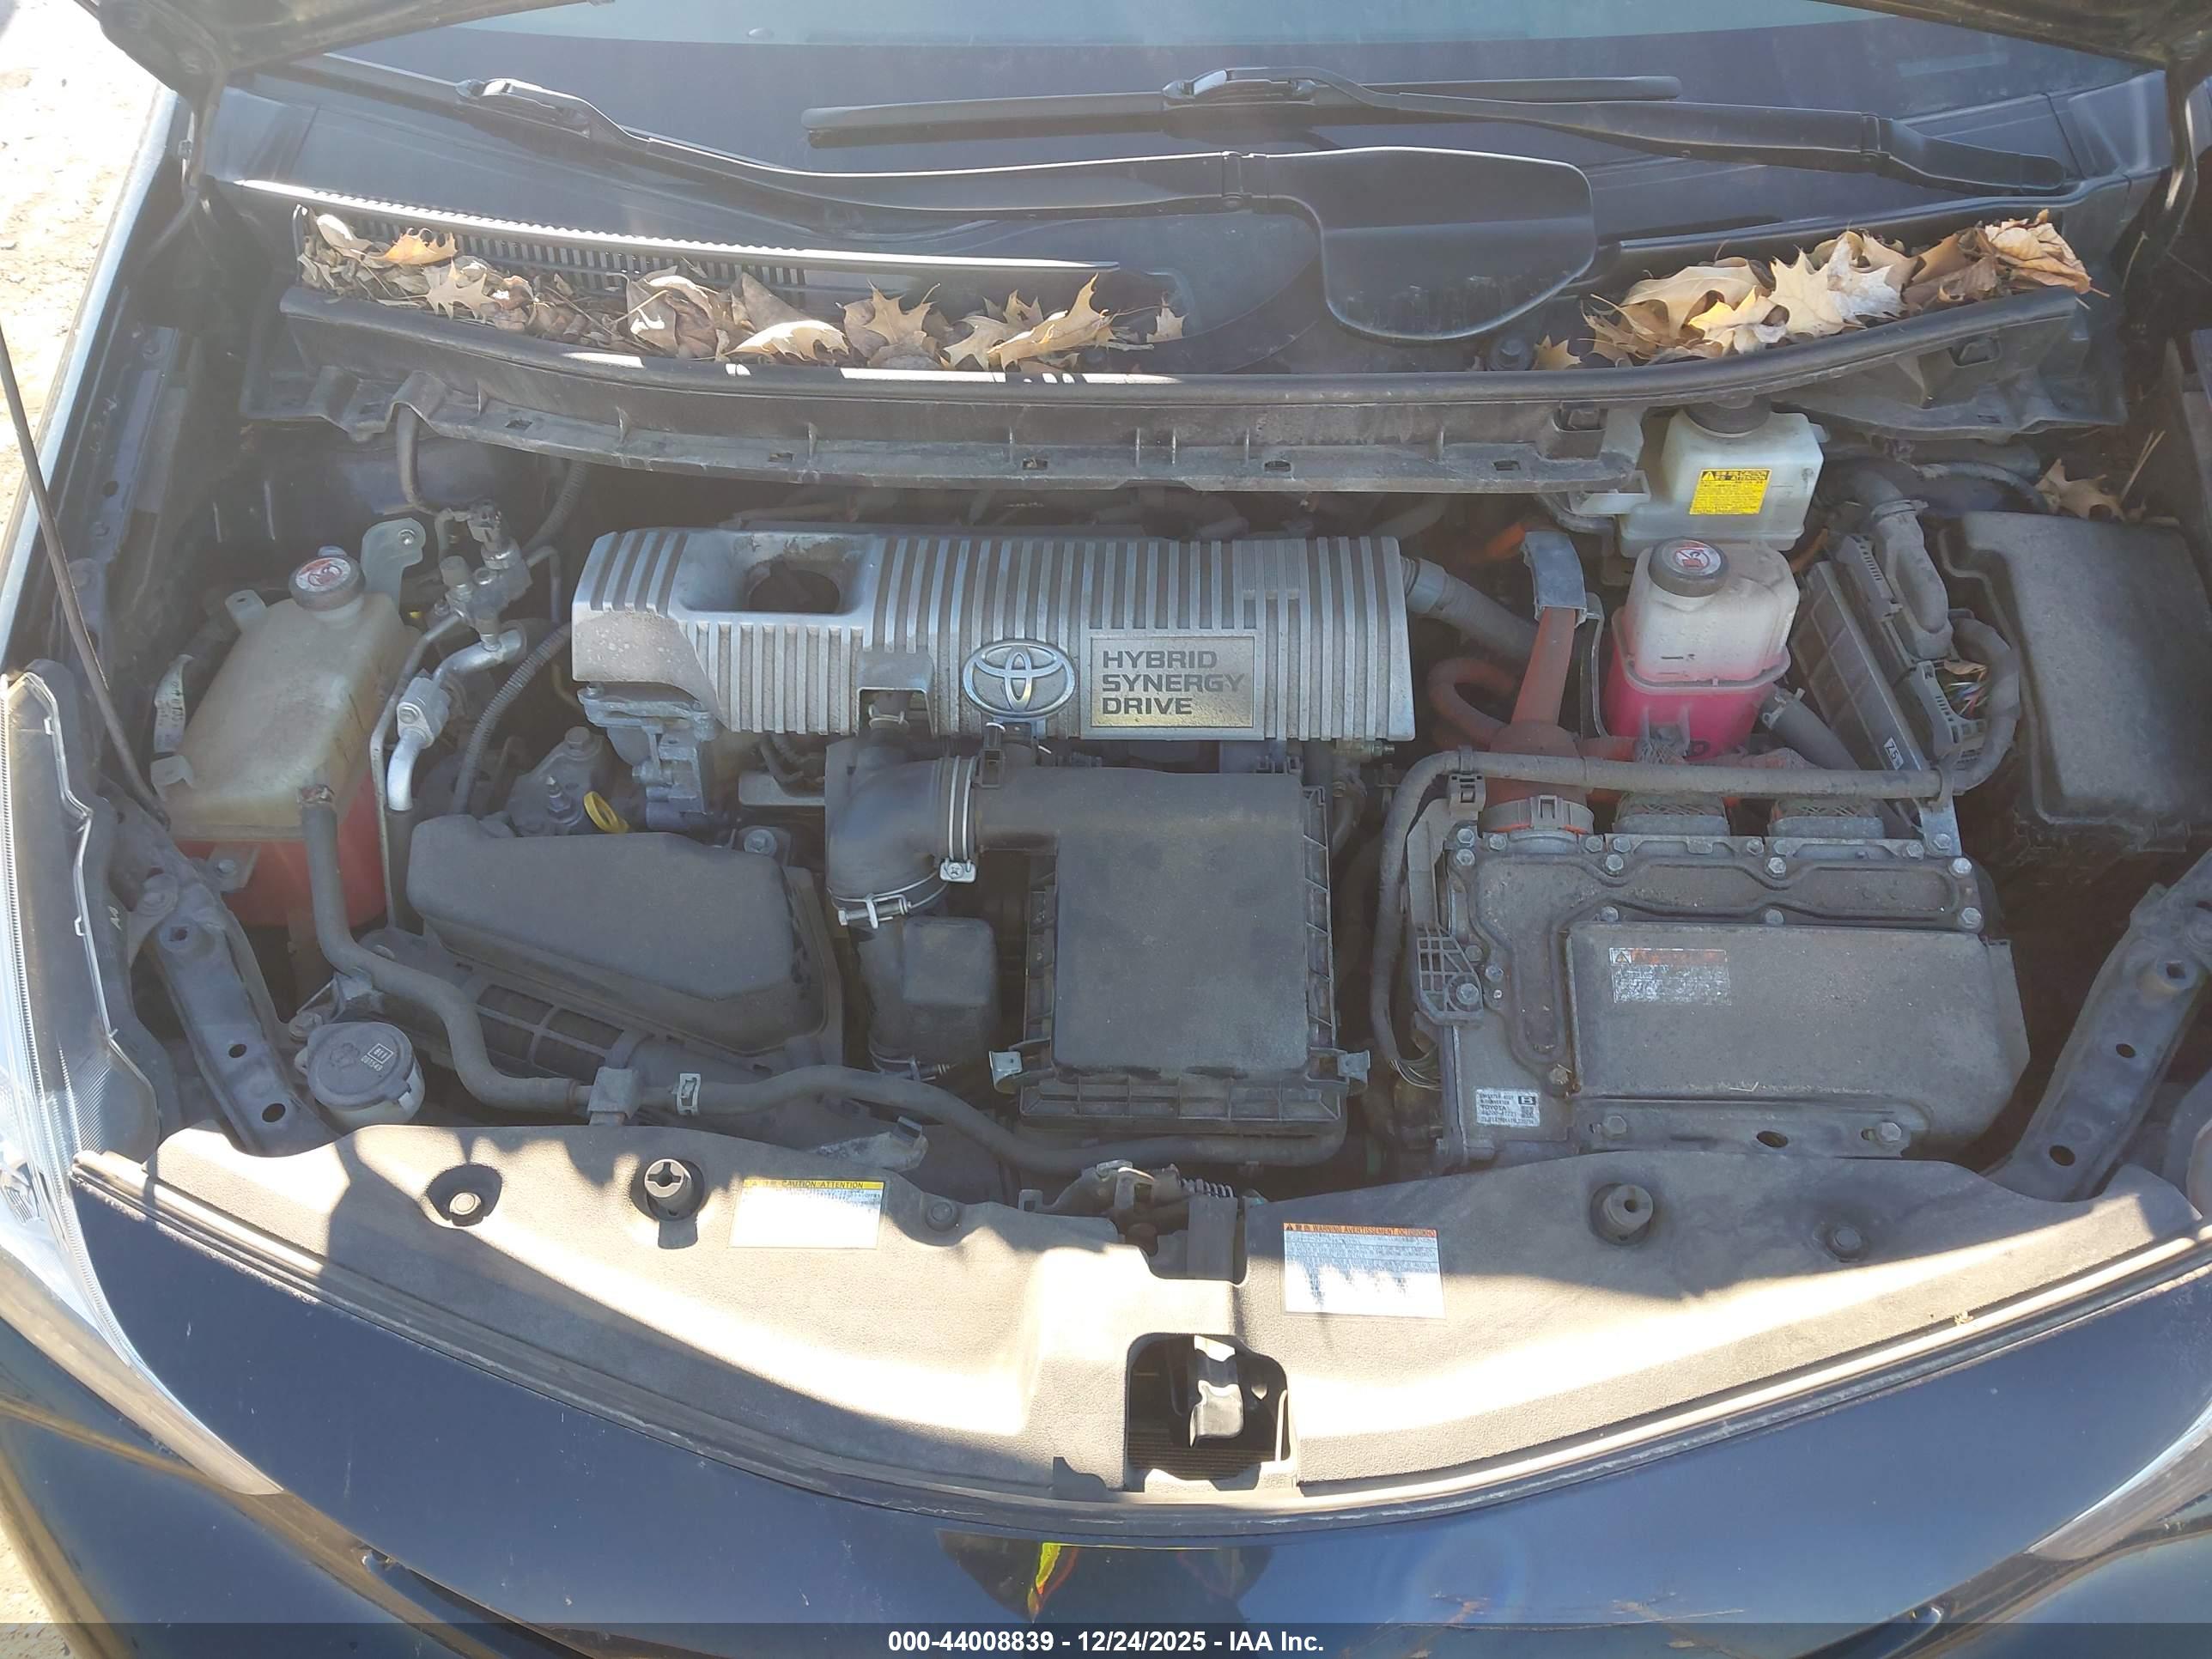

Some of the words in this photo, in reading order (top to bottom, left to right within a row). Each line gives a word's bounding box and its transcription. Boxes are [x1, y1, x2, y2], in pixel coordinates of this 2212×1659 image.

[1103, 650, 1218, 669] HYBRID
[1103, 673, 1245, 692] SYNERGY
[1103, 696, 1193, 715] DRIVE
[1313, 1224, 1342, 1233] WARNING
[1344, 1226, 1396, 1236] AVERTISSEMENT
